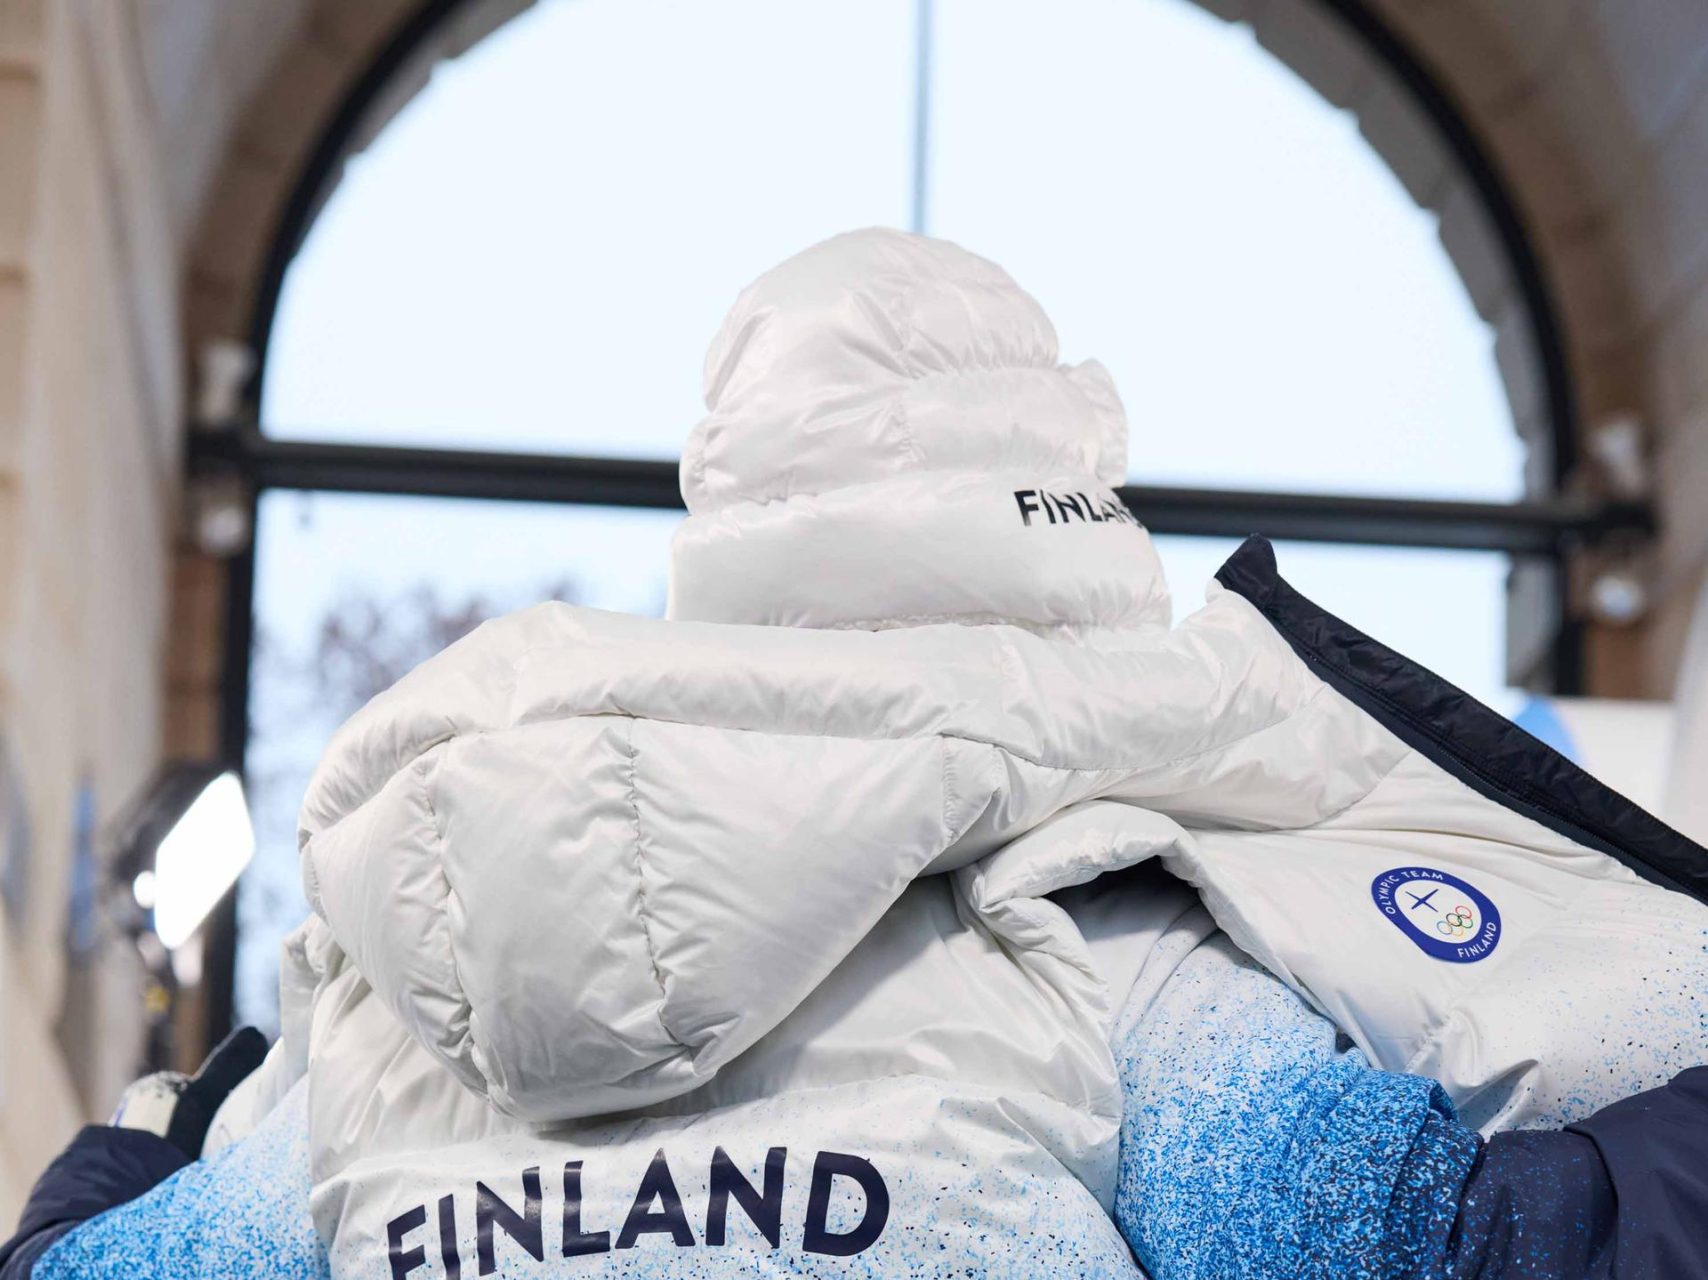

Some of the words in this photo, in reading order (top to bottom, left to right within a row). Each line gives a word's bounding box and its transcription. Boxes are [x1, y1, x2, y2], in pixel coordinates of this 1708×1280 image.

[1378, 875, 1400, 914] OLYMPIC
[1401, 870, 1444, 880] TEAM
[1457, 921, 1497, 958] FINLAND
